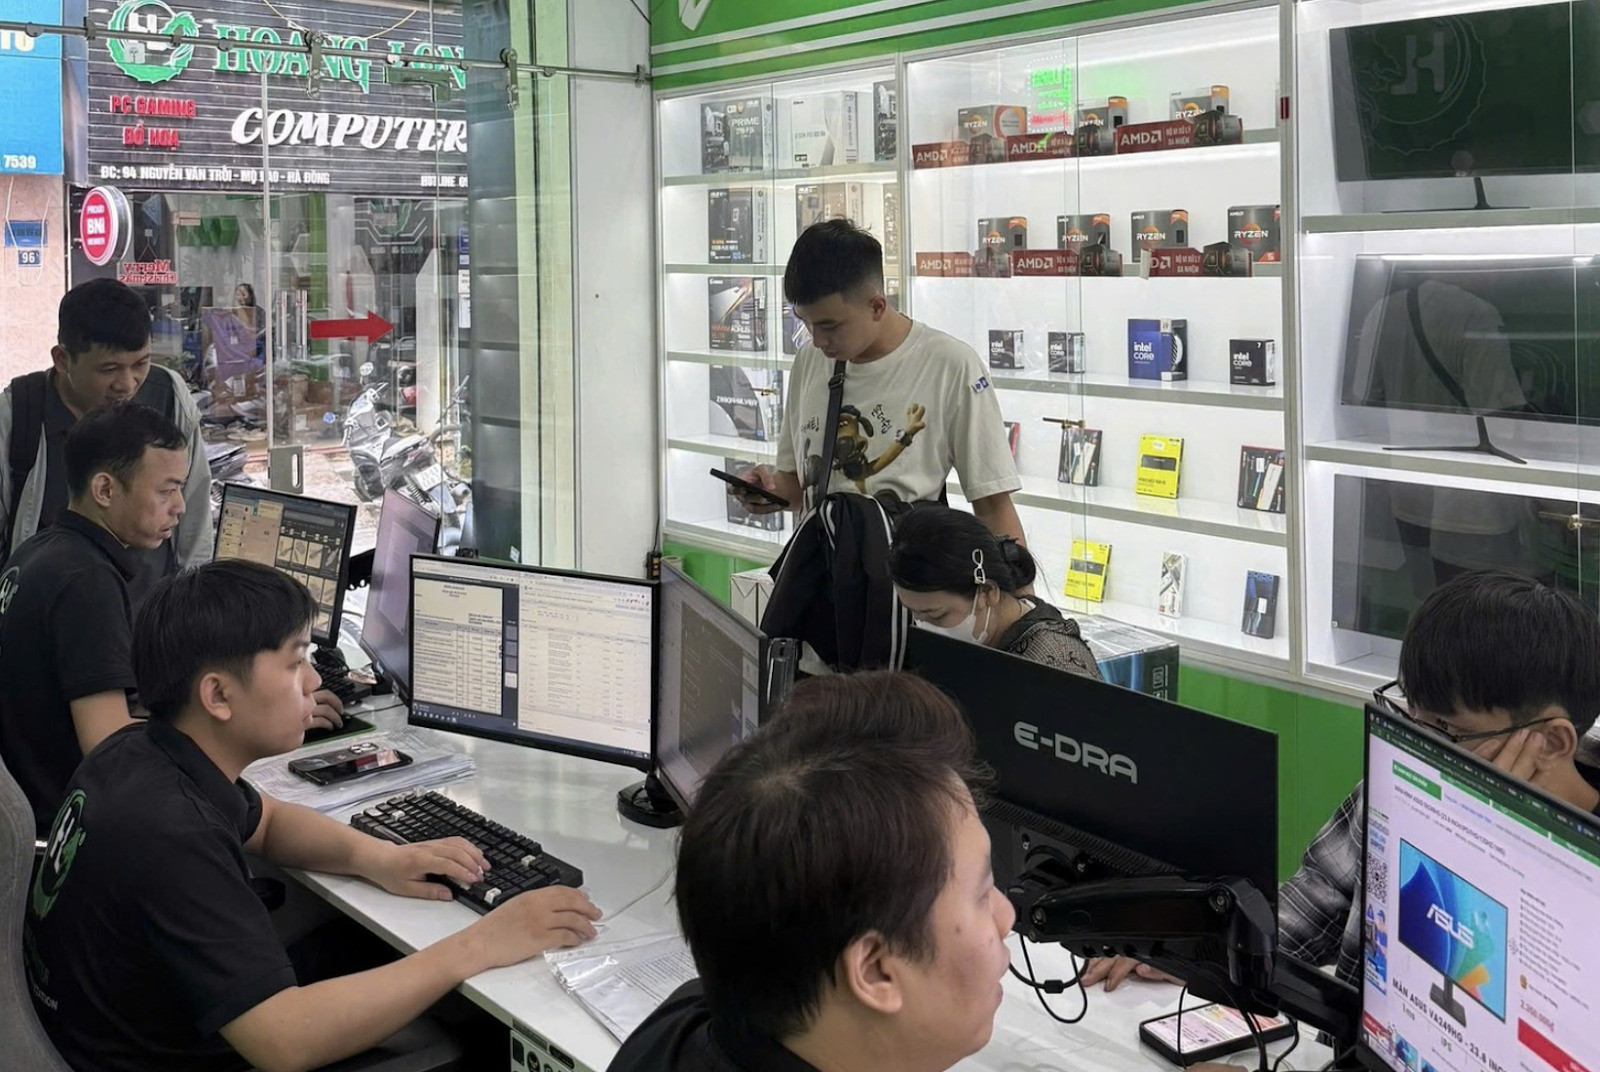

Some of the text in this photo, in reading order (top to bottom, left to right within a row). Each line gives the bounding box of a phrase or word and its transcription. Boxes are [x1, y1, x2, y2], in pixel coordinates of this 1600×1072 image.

[110, 94, 197, 119] PC GAMING
[231, 107, 468, 153] COMPUTER
[1120, 131, 1149, 146] AMD
[1011, 142, 1037, 155] AMD
[3, 155, 37, 169] 7539
[916, 150, 939, 163] AMD
[122, 166, 137, 179] 94
[420, 176, 456, 187] HOTLINE
[87, 216, 105, 235] BNI
[1062, 234, 1089, 242] RYZEN
[1136, 232, 1166, 240] RYZEN
[1234, 230, 1269, 238] RYZEN
[1267, 252, 1275, 261] 5
[919, 260, 943, 270] AMD
[1017, 259, 1043, 269] AMD
[1133, 341, 1152, 352] intel
[1233, 351, 1250, 360] intel
[1013, 721, 1138, 785] E-DRA
[1426, 903, 1475, 949] ASUS
[1392, 977, 1409, 998] MÀN
[1409, 993, 1428, 1014] ASUS
[1428, 1008, 1464, 1043] VA249HG
[1469, 1042, 1487, 1063] 23.8
[1440, 1036, 1453, 1053] IPS
